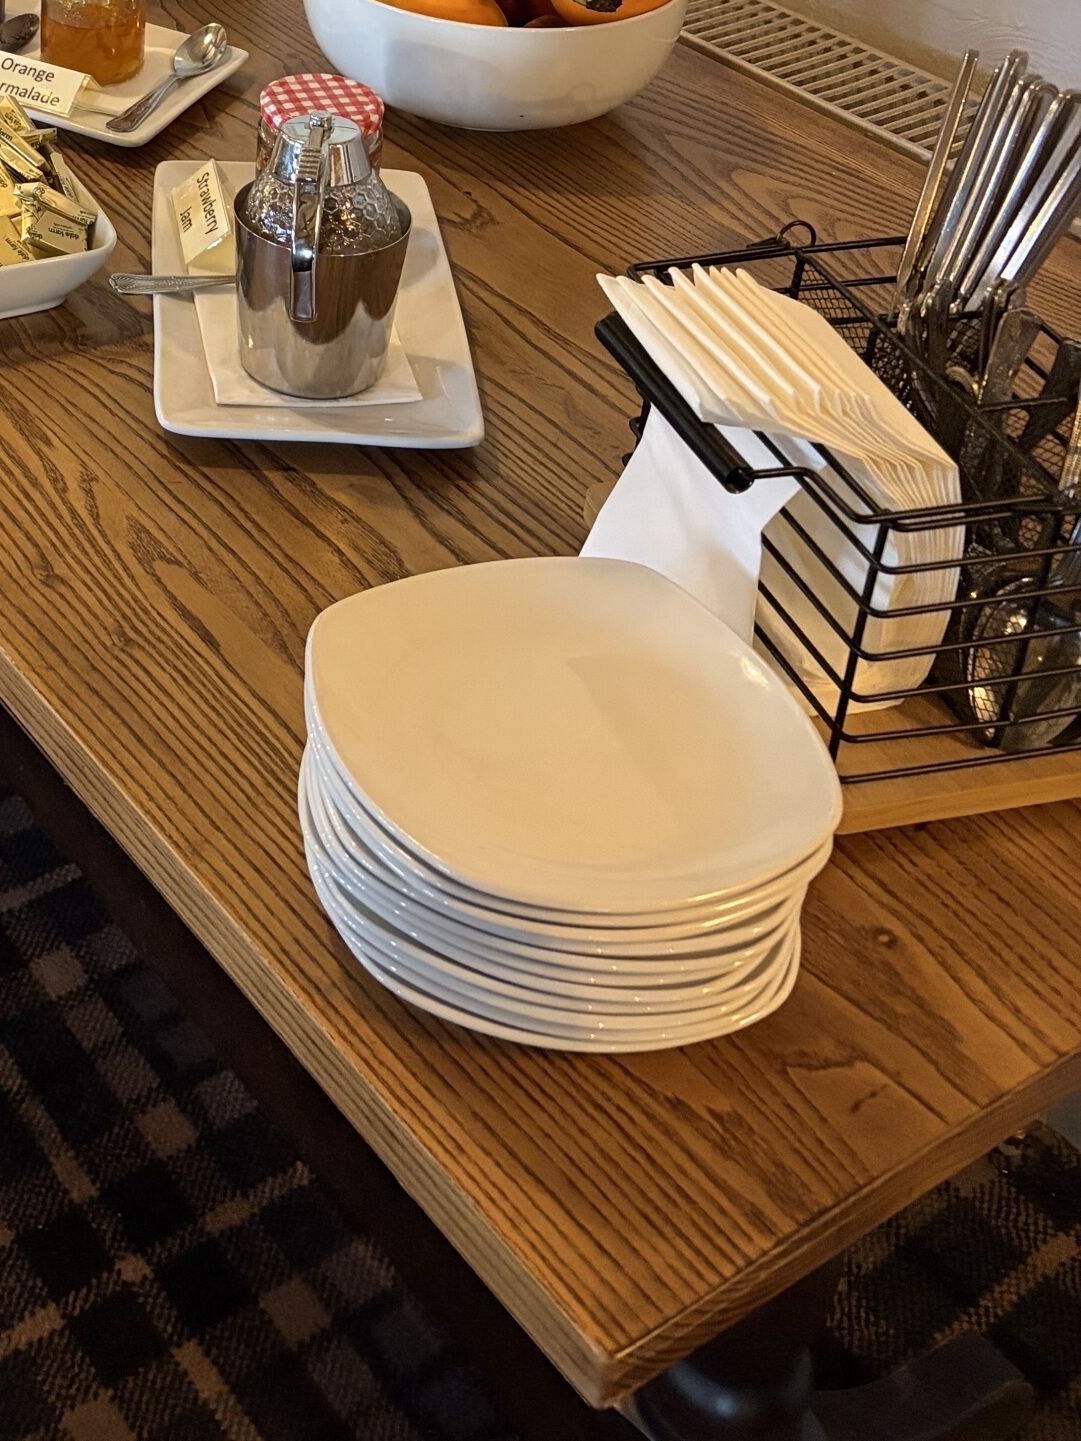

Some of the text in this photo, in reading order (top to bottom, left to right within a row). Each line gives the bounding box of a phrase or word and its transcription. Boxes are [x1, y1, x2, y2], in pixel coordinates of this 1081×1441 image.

[1, 57, 55, 83] Orange
[196, 172, 219, 235] Strawberry
[179, 206, 193, 233] Jam
[5, 237, 21, 253] farm
